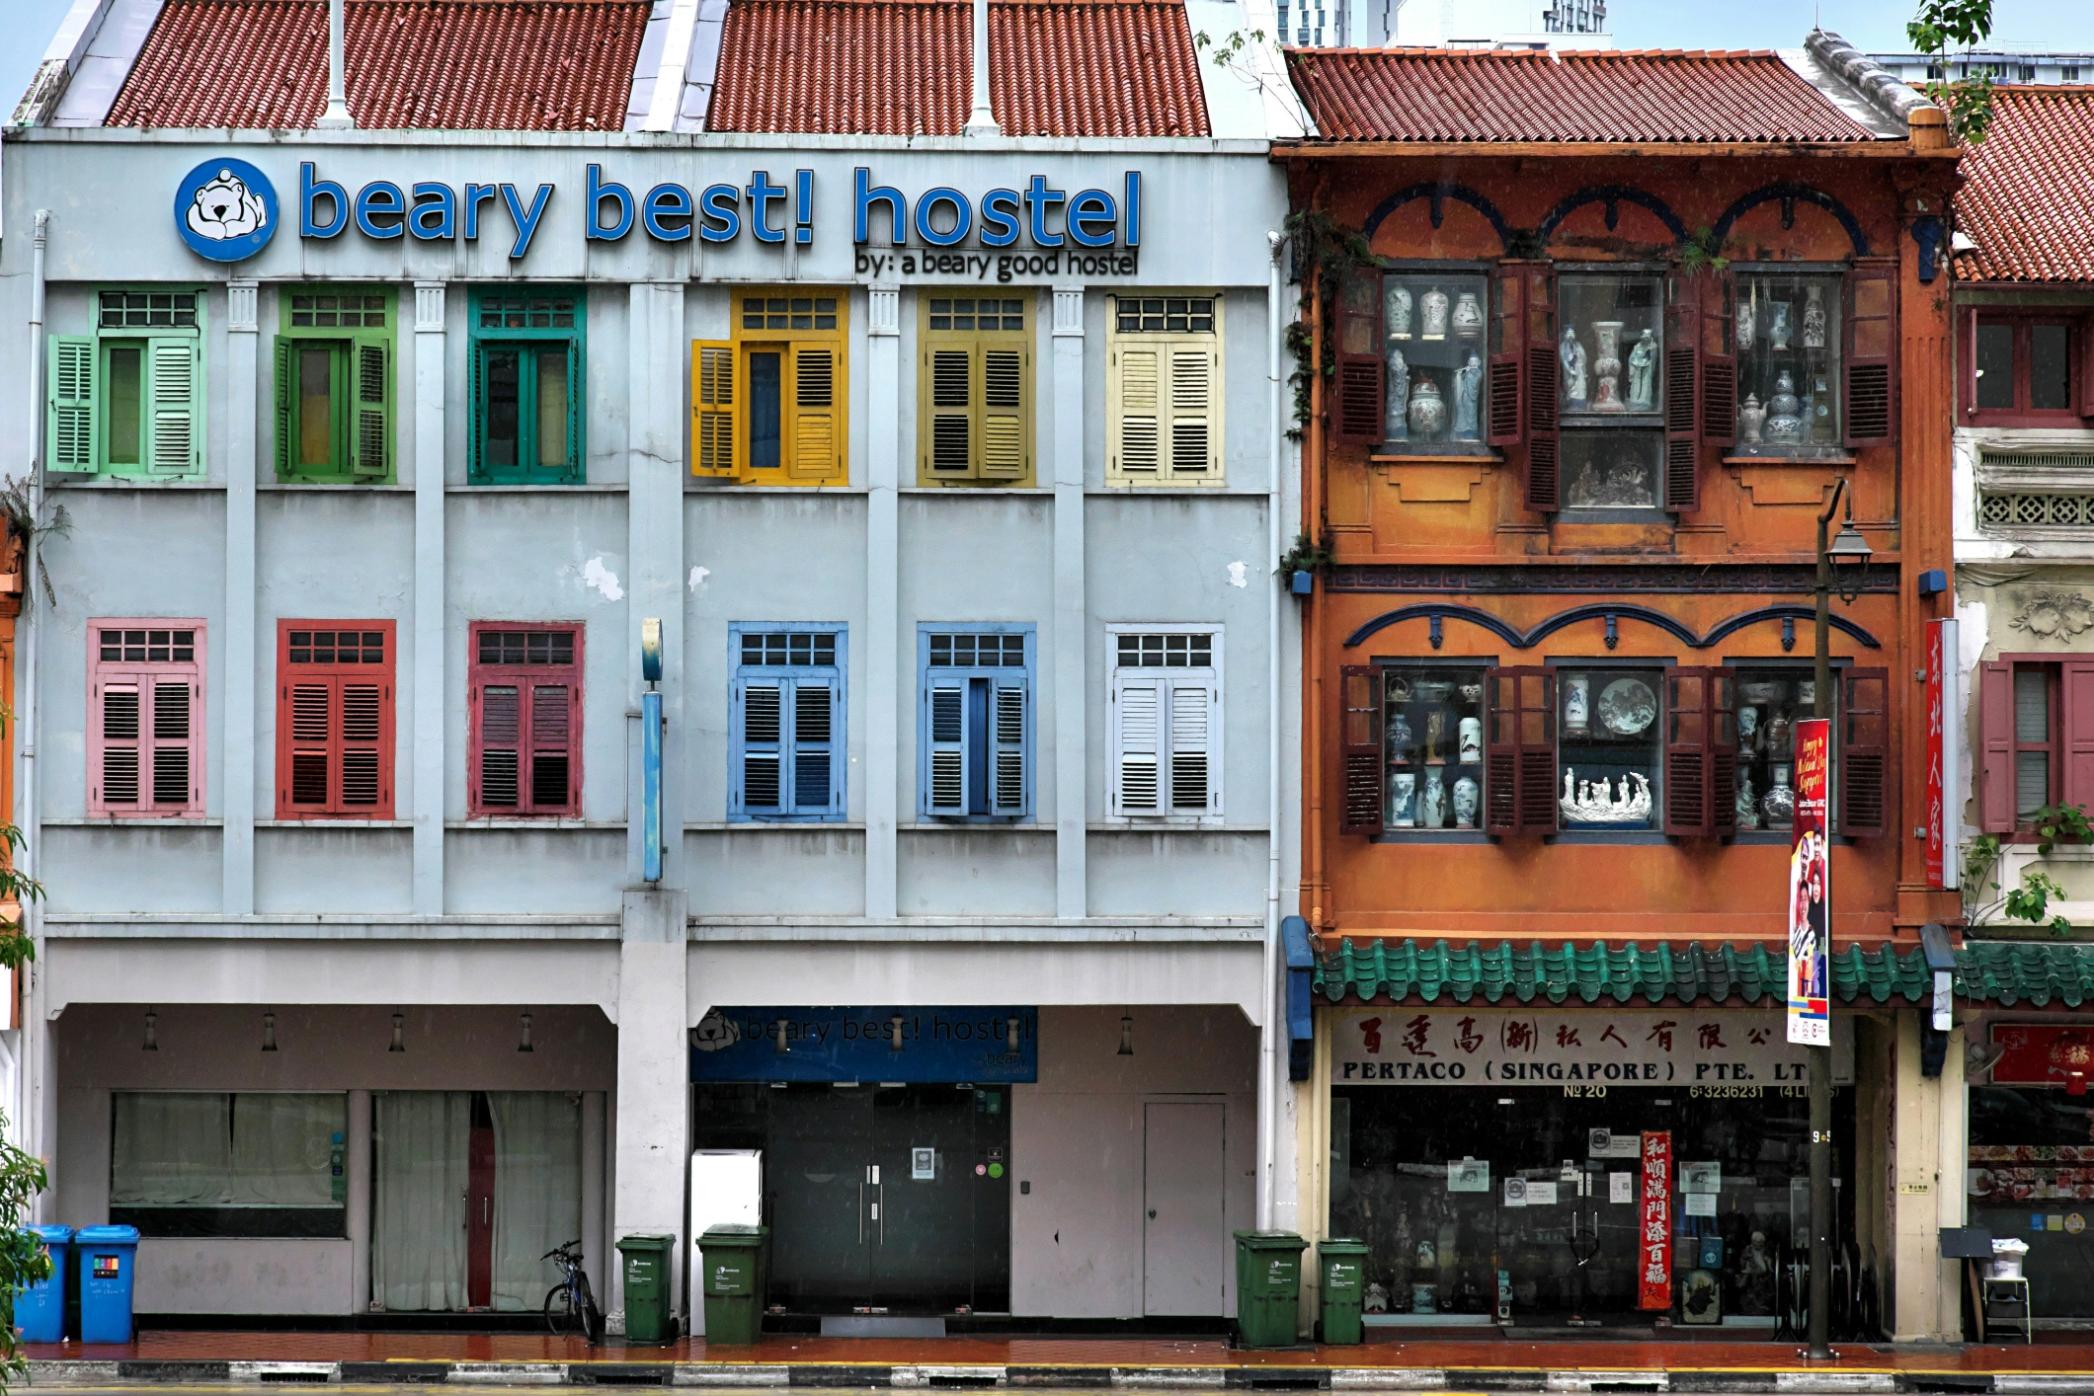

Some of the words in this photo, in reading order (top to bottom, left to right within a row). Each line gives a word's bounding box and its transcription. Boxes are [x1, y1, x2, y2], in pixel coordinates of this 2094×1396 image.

[300, 161, 555, 259] beary
[586, 163, 815, 246] best!
[853, 167, 1142, 248] hostel
[855, 252, 894, 278] by:
[901, 254, 916, 275] a
[922, 251, 991, 279] beary
[997, 252, 1060, 282] good
[1067, 252, 1138, 276] hostel
[747, 1016, 831, 1045] beary
[842, 1015, 922, 1041] best!
[1343, 1062, 1466, 1080] PERTACO
[1695, 1063, 1755, 1081] PTE.
[1774, 1062, 1808, 1080] LT
[1585, 1084, 1607, 1098] 20
